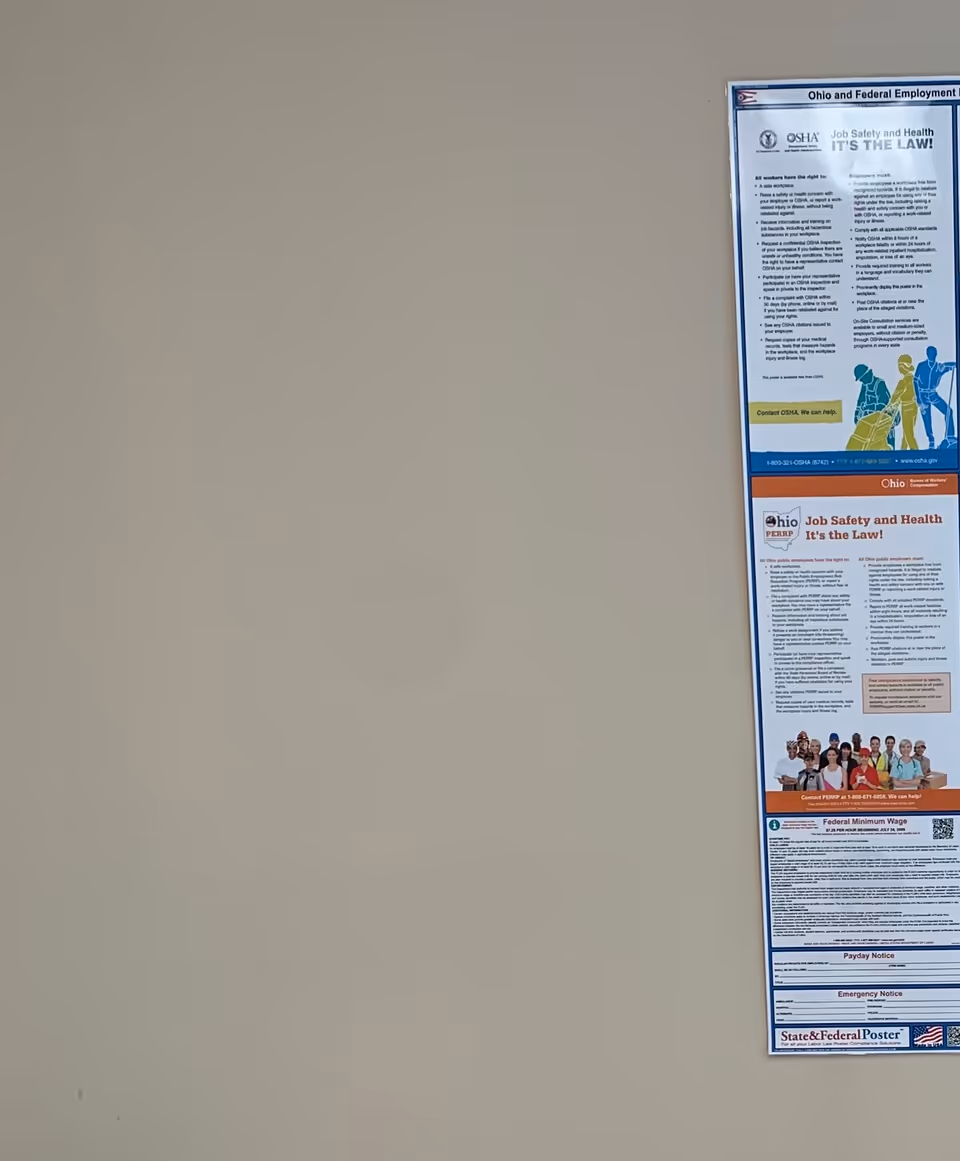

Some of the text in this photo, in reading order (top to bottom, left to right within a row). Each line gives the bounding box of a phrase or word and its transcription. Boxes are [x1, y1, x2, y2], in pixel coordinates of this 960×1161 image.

[808, 90, 832, 100] Ohio
[834, 90, 853, 99] and
[855, 89, 892, 99] Federal
[894, 88, 956, 100] Employment
[787, 132, 819, 143] OSHA
[831, 128, 934, 141] Job Safety and Health
[831, 140, 858, 151] IT'S
[862, 139, 892, 151] THE
[897, 138, 933, 150] LAW!
[822, 408, 837, 416] help.
[881, 478, 905, 488] Ohio
[765, 515, 798, 528] Ohio
[805, 514, 942, 527] Job Safety and Health
[806, 530, 883, 540] It's the Law!
[851, 817, 885, 825] Minimum
[886, 817, 907, 826] Wage
[844, 952, 869, 960] Payday
[838, 990, 878, 999] Emergency
